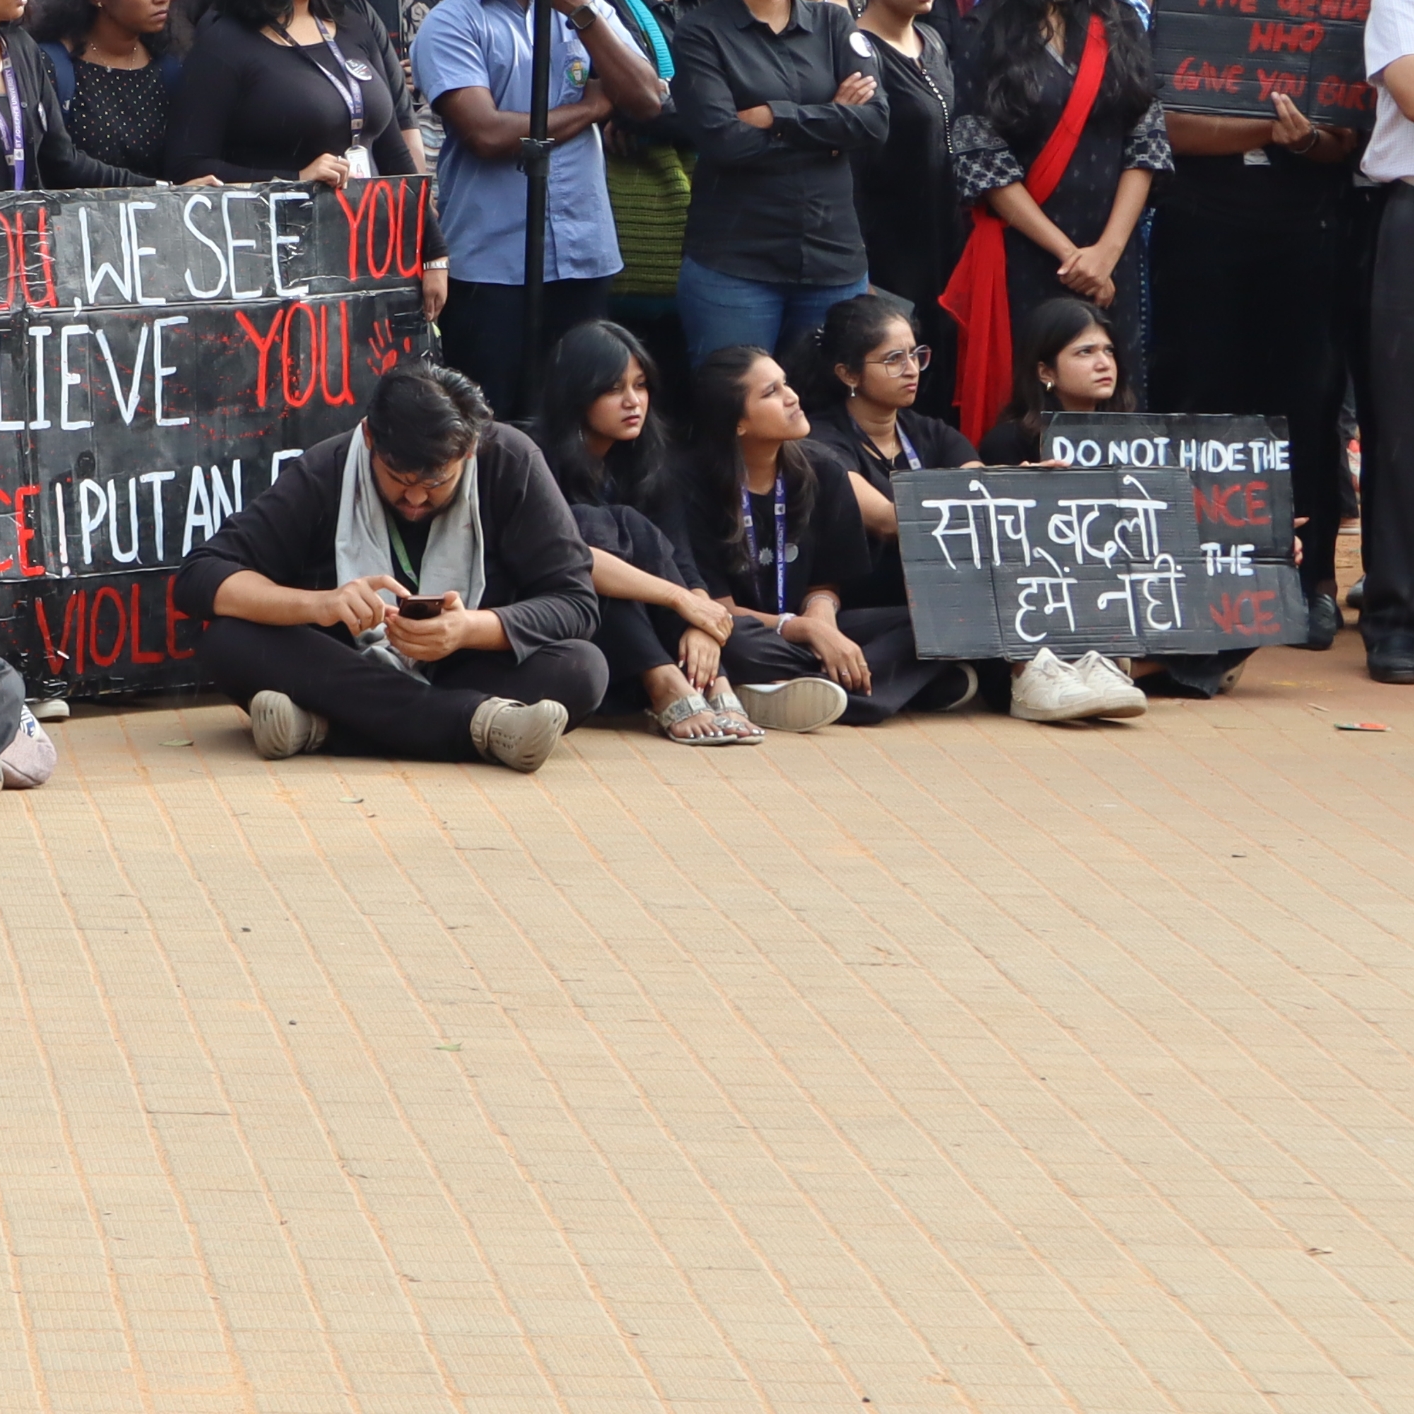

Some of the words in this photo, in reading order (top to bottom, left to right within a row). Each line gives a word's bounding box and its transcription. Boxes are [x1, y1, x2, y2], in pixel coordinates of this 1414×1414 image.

[1172, 55, 1245, 94] GAVE
[1256, 68, 1307, 102] YOU
[78, 202, 167, 304] WE
[183, 190, 310, 300] SEE
[335, 178, 429, 282] YOU
[235, 299, 357, 409] YOU
[1053, 436, 1102, 467] DO
[1108, 436, 1170, 468] NOT
[1179, 438, 1245, 473] HIDE
[1248, 439, 1290, 473] THE
[79, 470, 176, 565] PUT
[921, 479, 1036, 571] सोच
[1047, 474, 1168, 570] बदलो
[1200, 542, 1255, 577] THE
[35, 575, 198, 675] VIOLE
[1014, 546, 1078, 643] हमें
[1097, 553, 1186, 636] नहीं
